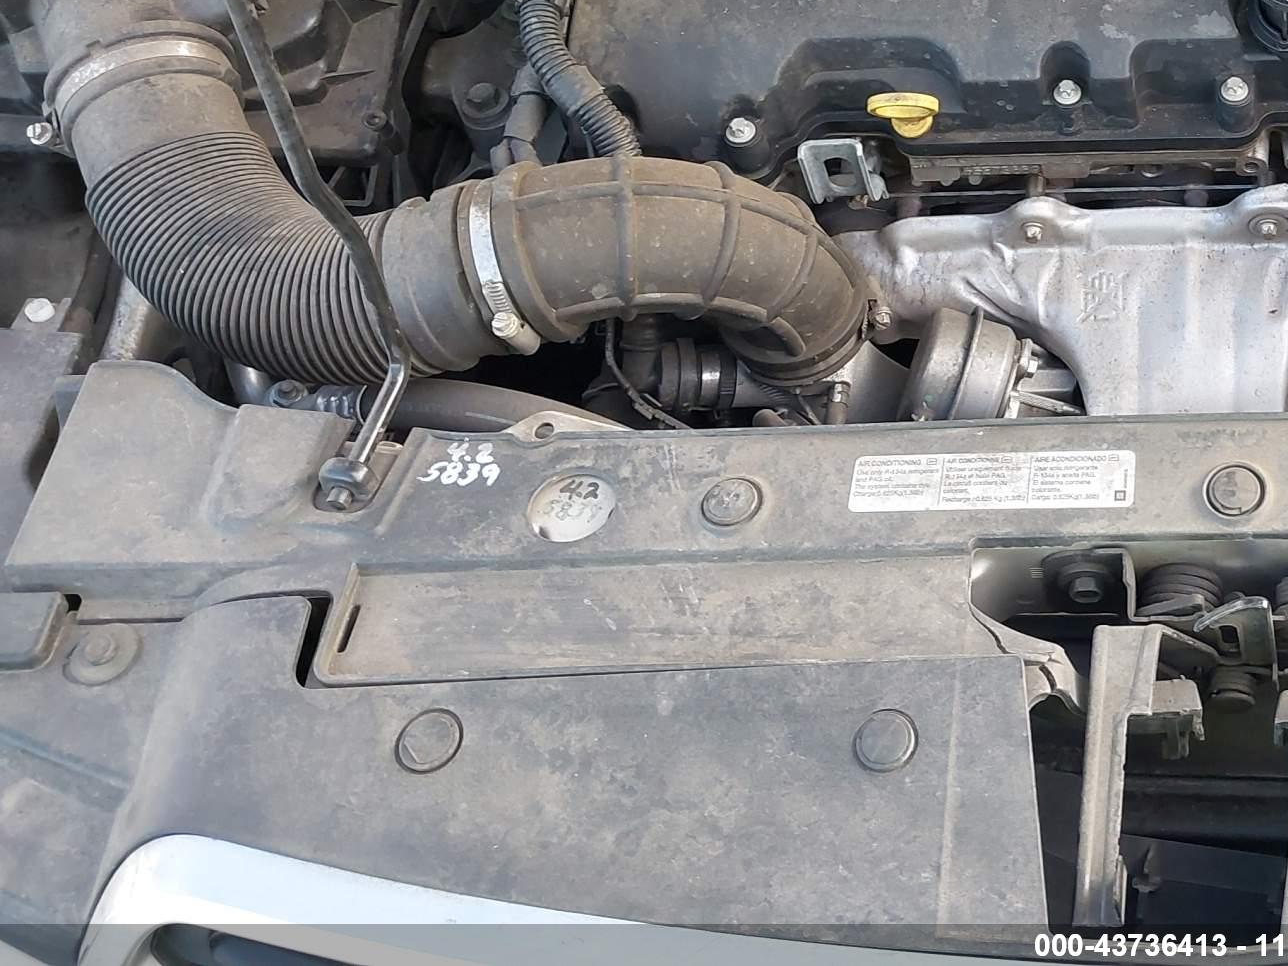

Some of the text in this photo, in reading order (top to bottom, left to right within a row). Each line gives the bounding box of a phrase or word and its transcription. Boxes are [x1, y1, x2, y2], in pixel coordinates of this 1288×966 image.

[447, 442, 495, 464] 4.2
[871, 459, 922, 467] CONDITIONING
[416, 461, 501, 487] 5839
[560, 478, 600, 500] 4.2
